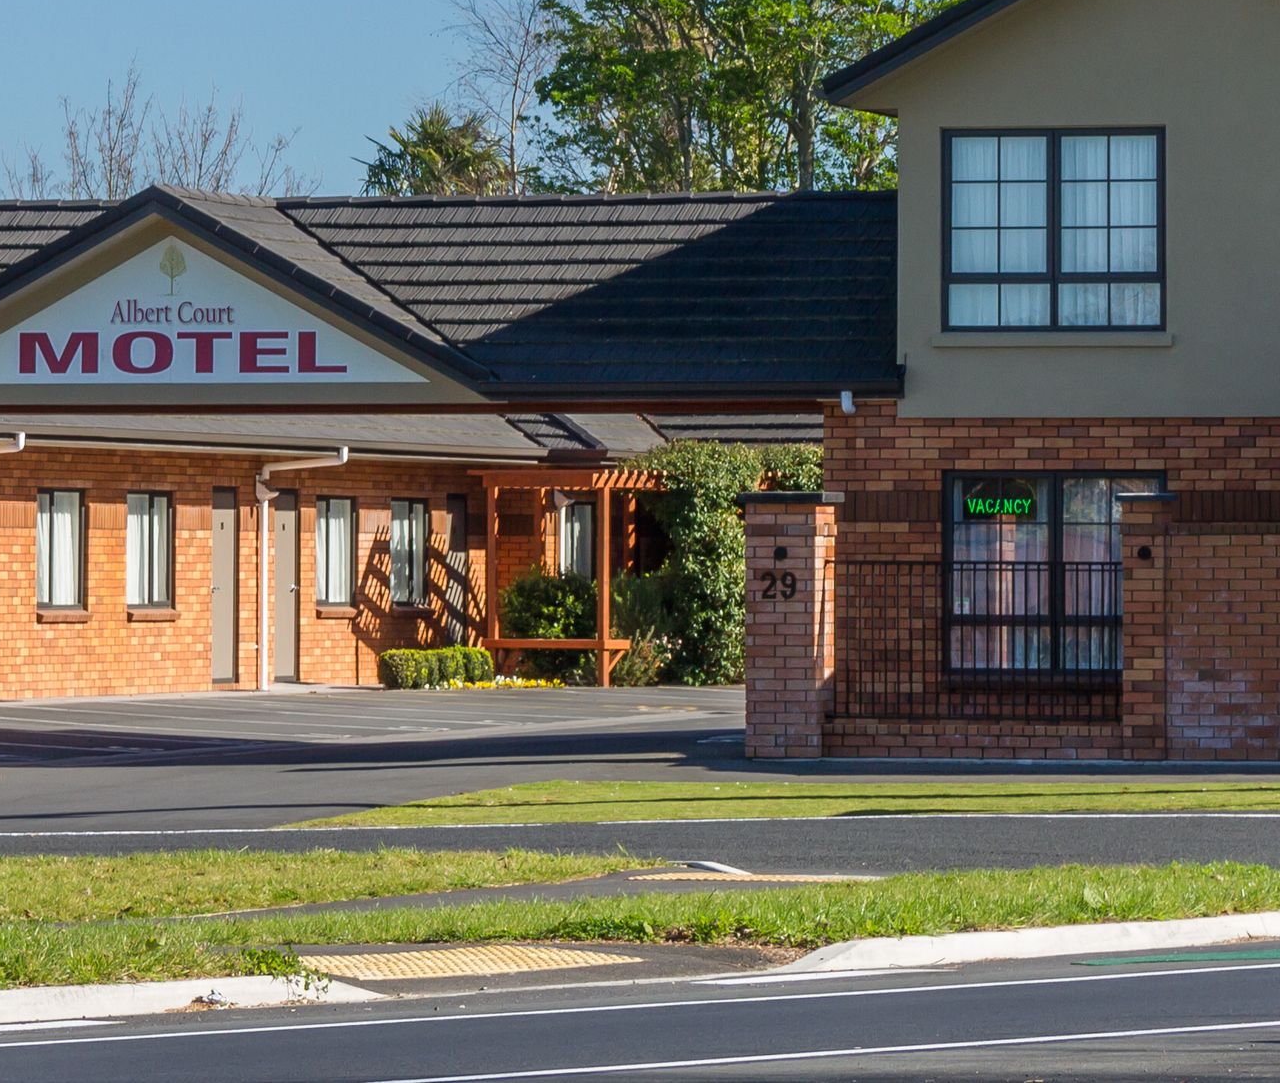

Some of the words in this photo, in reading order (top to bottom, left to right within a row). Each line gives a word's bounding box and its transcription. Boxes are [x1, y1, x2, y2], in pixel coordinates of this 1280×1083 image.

[111, 299, 172, 323] Albert
[177, 301, 234, 324] Court
[18, 331, 348, 374] MOTEL
[967, 498, 1031, 514] VACANCY
[760, 571, 797, 600] 29
